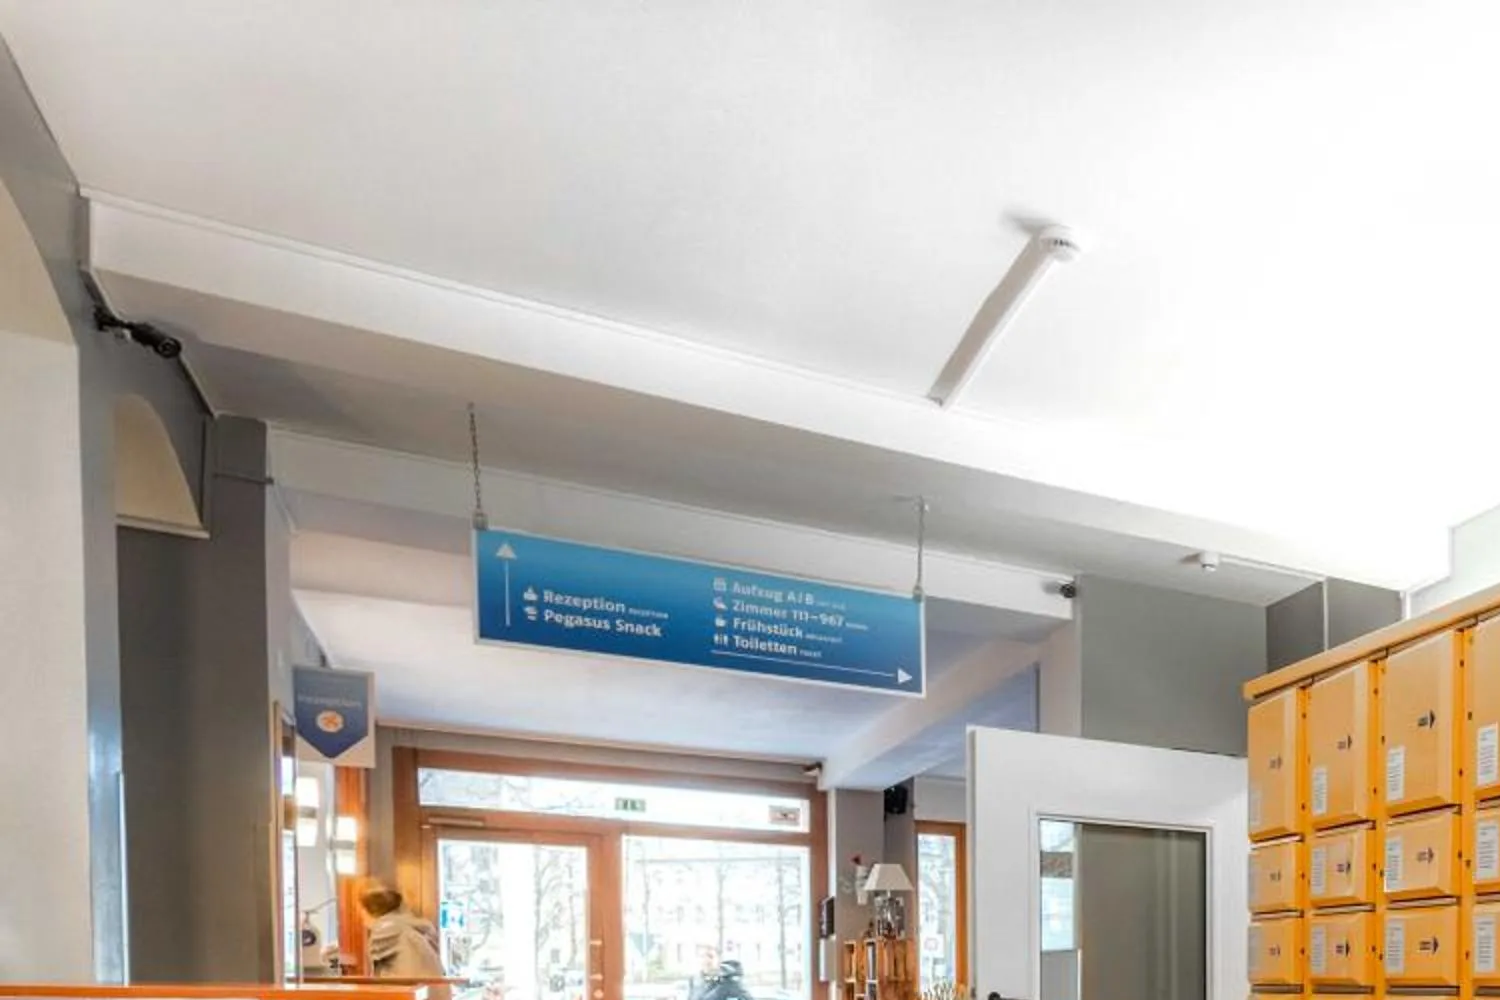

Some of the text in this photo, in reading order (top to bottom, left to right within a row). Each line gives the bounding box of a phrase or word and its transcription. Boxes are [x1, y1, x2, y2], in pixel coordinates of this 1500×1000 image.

[543, 590, 625, 613] Rezeption
[732, 582, 783, 602] Aufzug
[732, 600, 787, 618] Zimmer
[544, 609, 662, 637] Pegasus Snack
[733, 617, 803, 637] Frühstück
[733, 635, 797, 656] Toiletten
